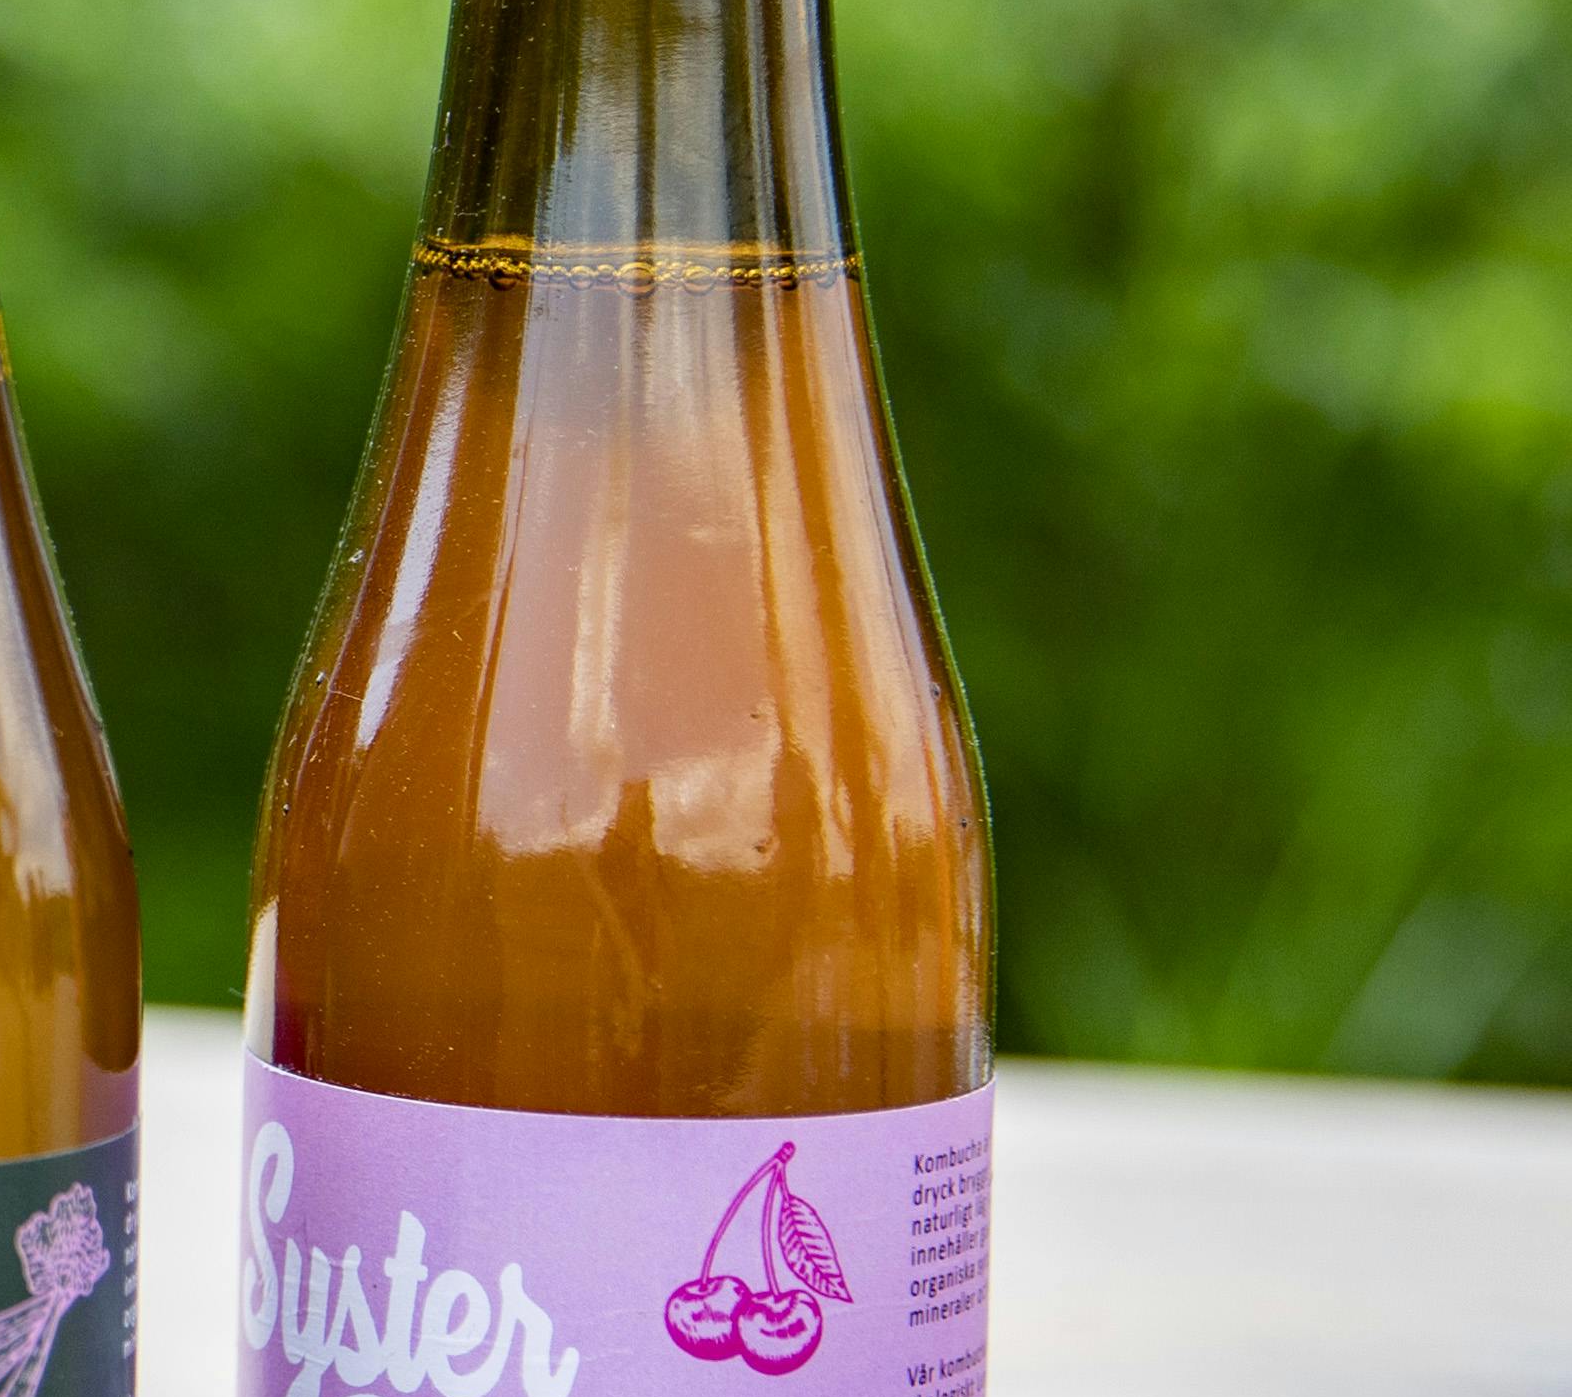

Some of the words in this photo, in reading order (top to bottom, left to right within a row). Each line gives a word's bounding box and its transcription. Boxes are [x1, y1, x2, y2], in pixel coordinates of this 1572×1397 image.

[913, 1139, 982, 1176] Kombucha
[911, 1177, 956, 1207] dryck
[910, 1259, 976, 1298] organiska
[909, 1292, 976, 1328] mineraler
[906, 1363, 935, 1387] Vår
